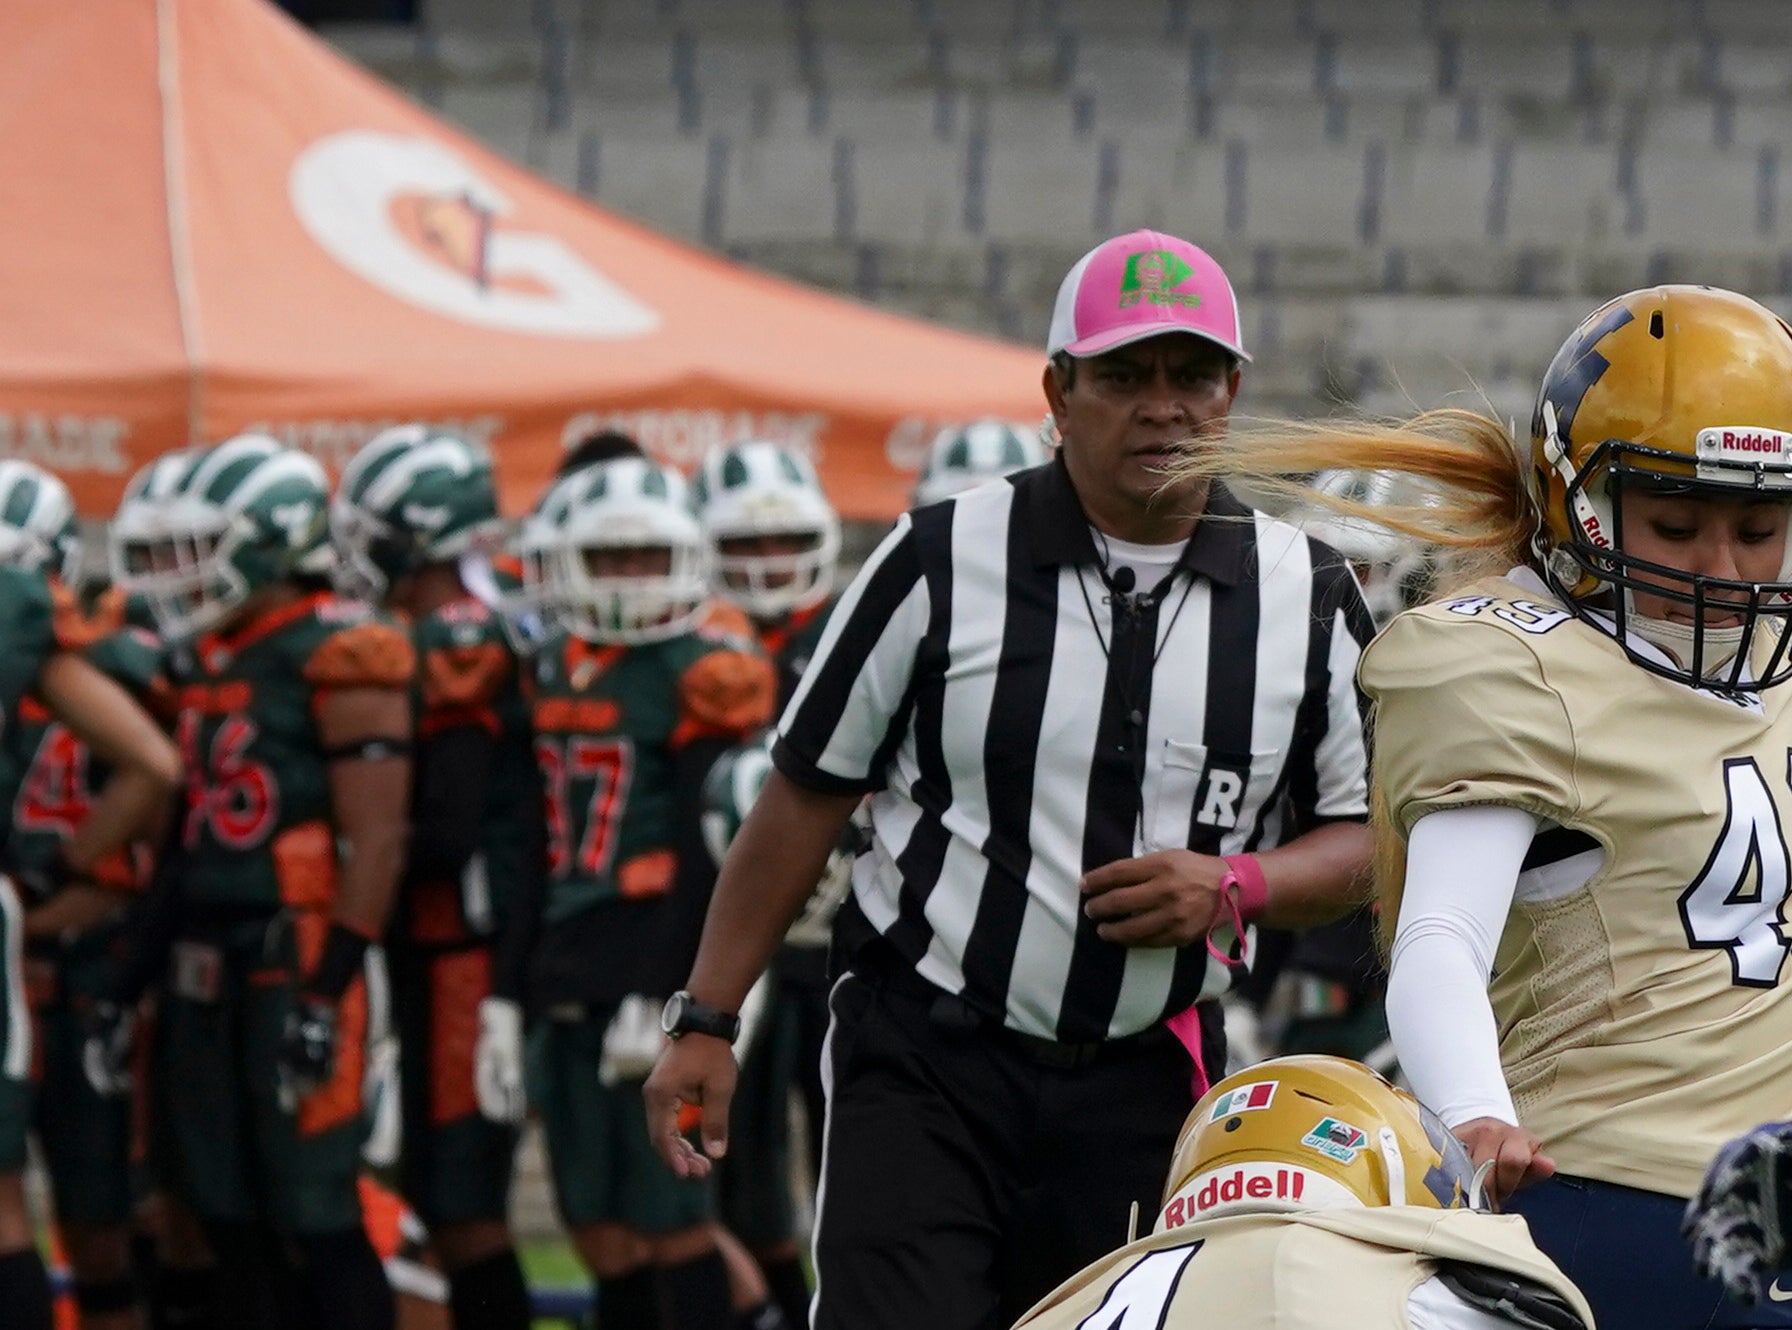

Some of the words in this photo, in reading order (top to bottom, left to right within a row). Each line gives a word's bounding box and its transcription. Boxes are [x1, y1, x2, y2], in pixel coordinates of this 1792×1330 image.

[1722, 431, 1782, 453] Riddell
[1197, 768, 1243, 829] R
[1164, 1169, 1305, 1230] Riddell
